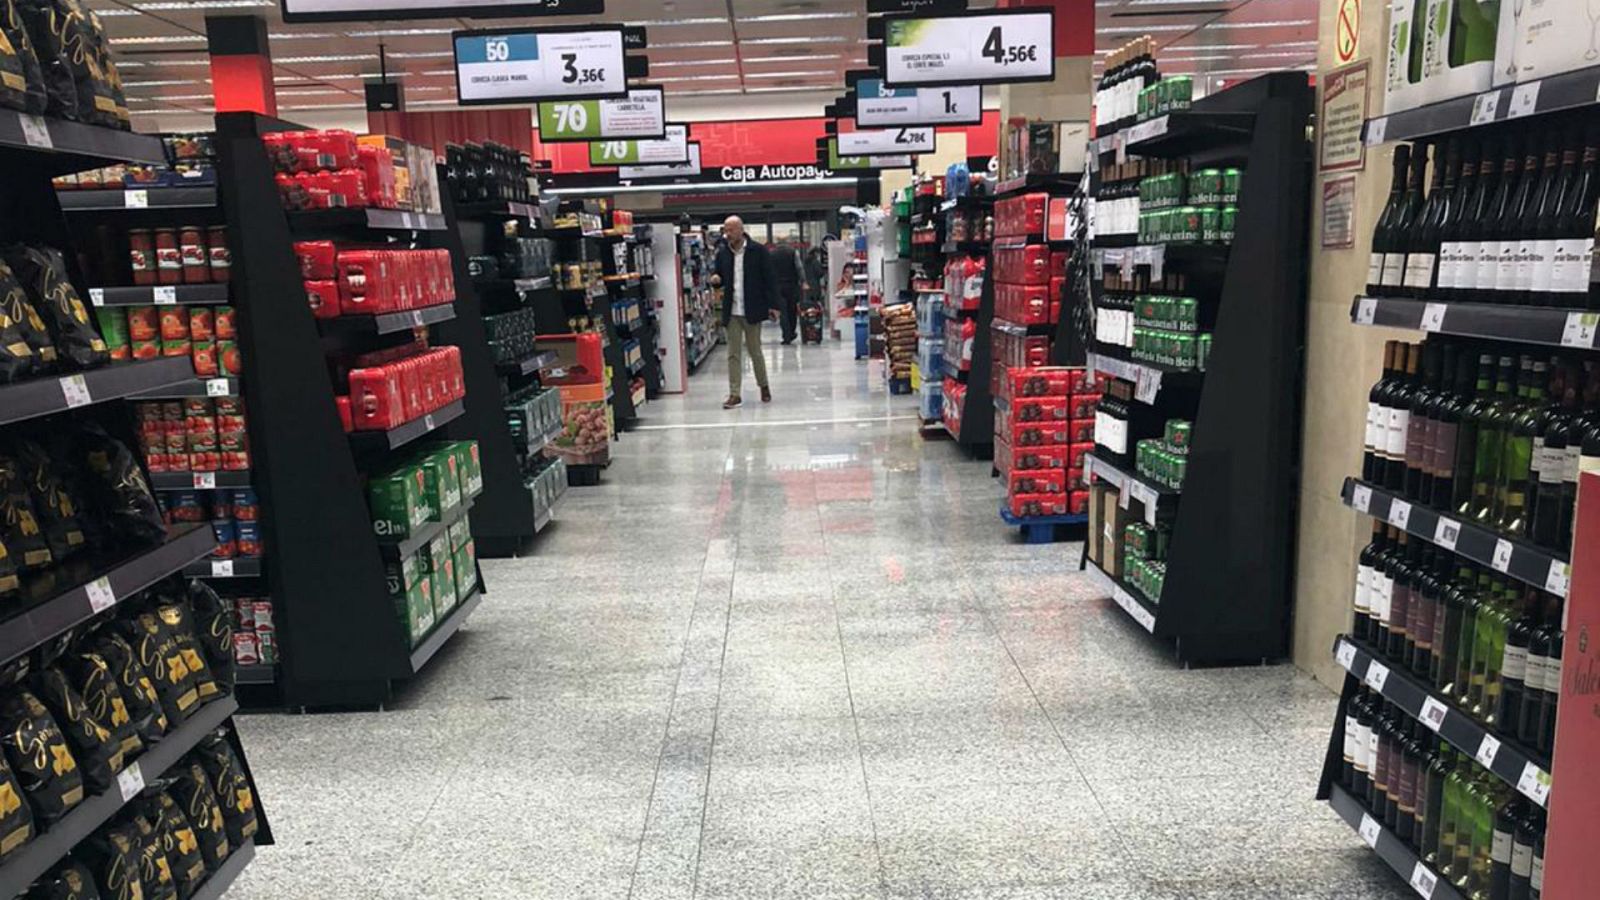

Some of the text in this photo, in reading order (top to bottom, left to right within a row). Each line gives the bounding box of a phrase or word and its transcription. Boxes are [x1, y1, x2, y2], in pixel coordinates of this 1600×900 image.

[981, 26, 1037, 66] 4,56€
[561, 53, 606, 85] 3,36€
[721, 165, 755, 183] Caja
